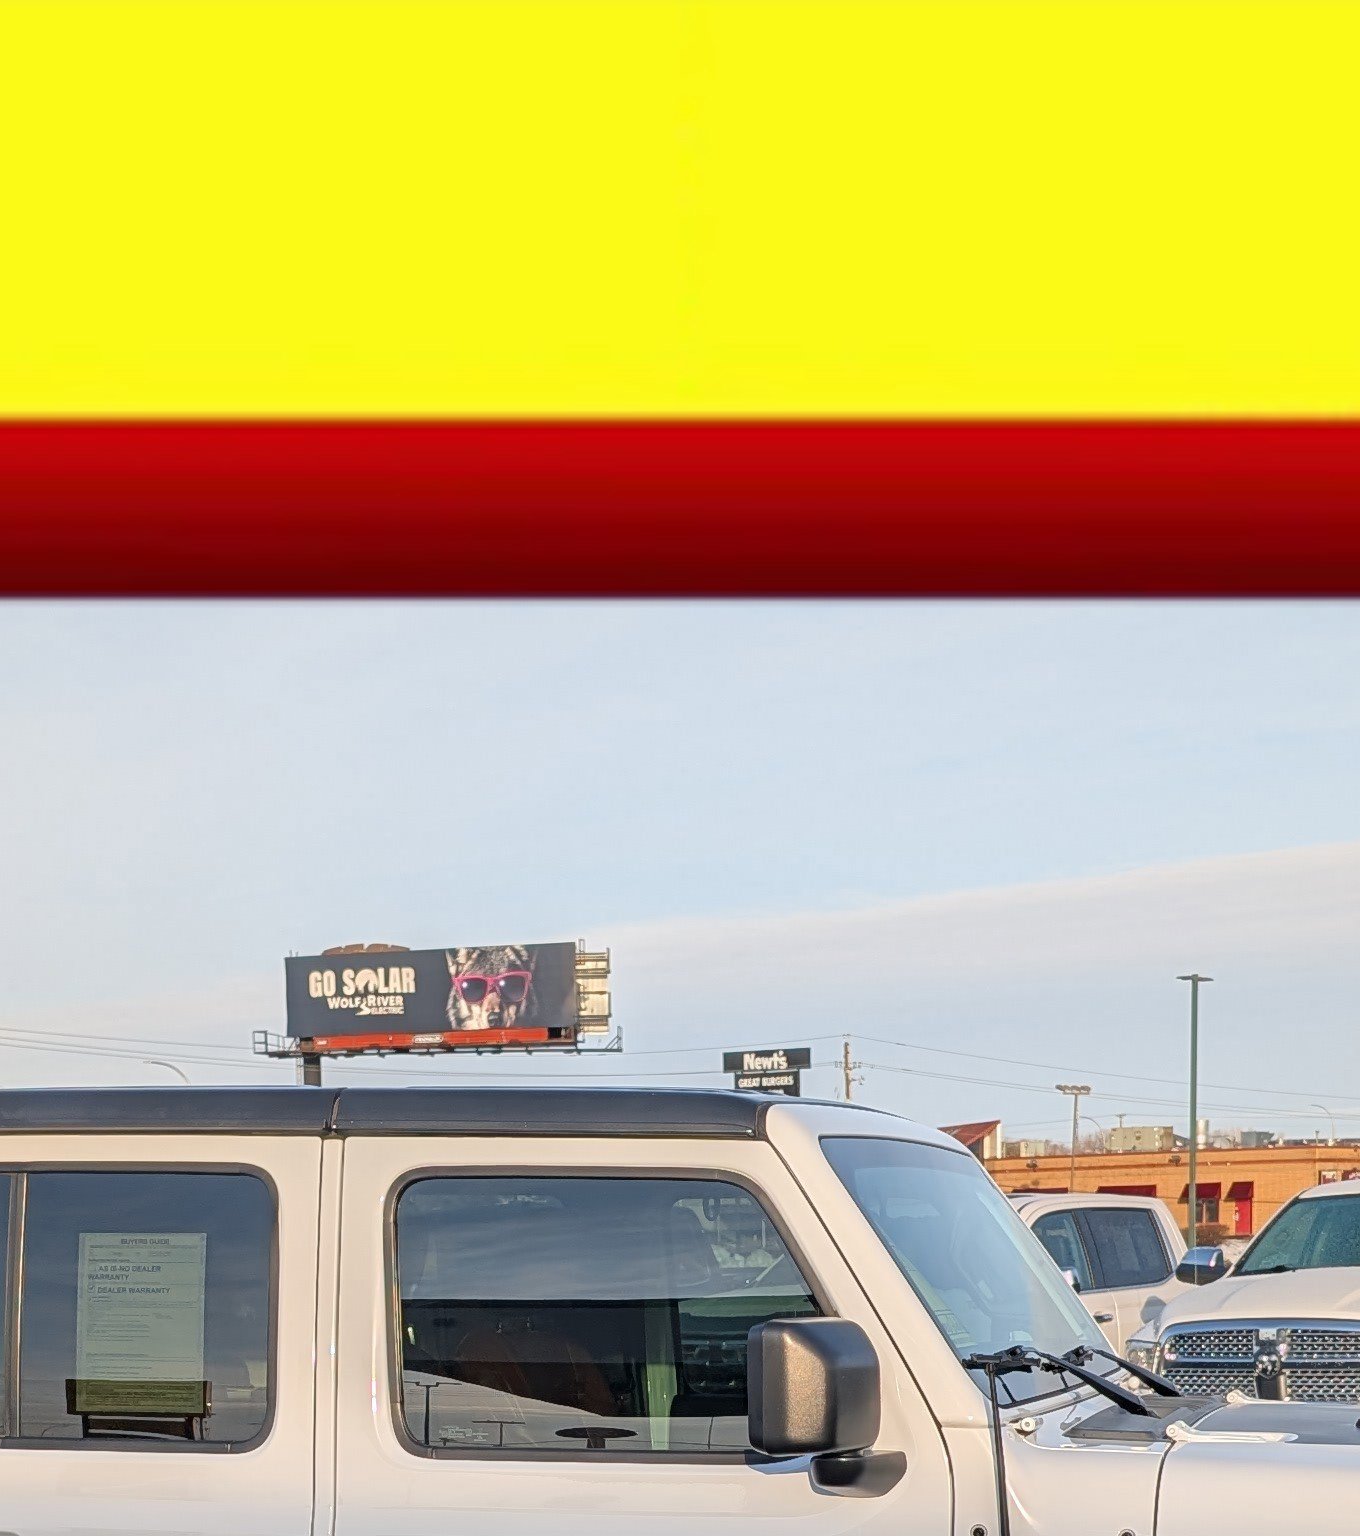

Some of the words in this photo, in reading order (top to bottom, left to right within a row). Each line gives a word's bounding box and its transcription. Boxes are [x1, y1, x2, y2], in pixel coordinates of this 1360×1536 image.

[308, 969, 337, 998] GO
[327, 996, 361, 1010] WOLF
[367, 994, 404, 1007] RIVER
[742, 1050, 788, 1071] Newt's
